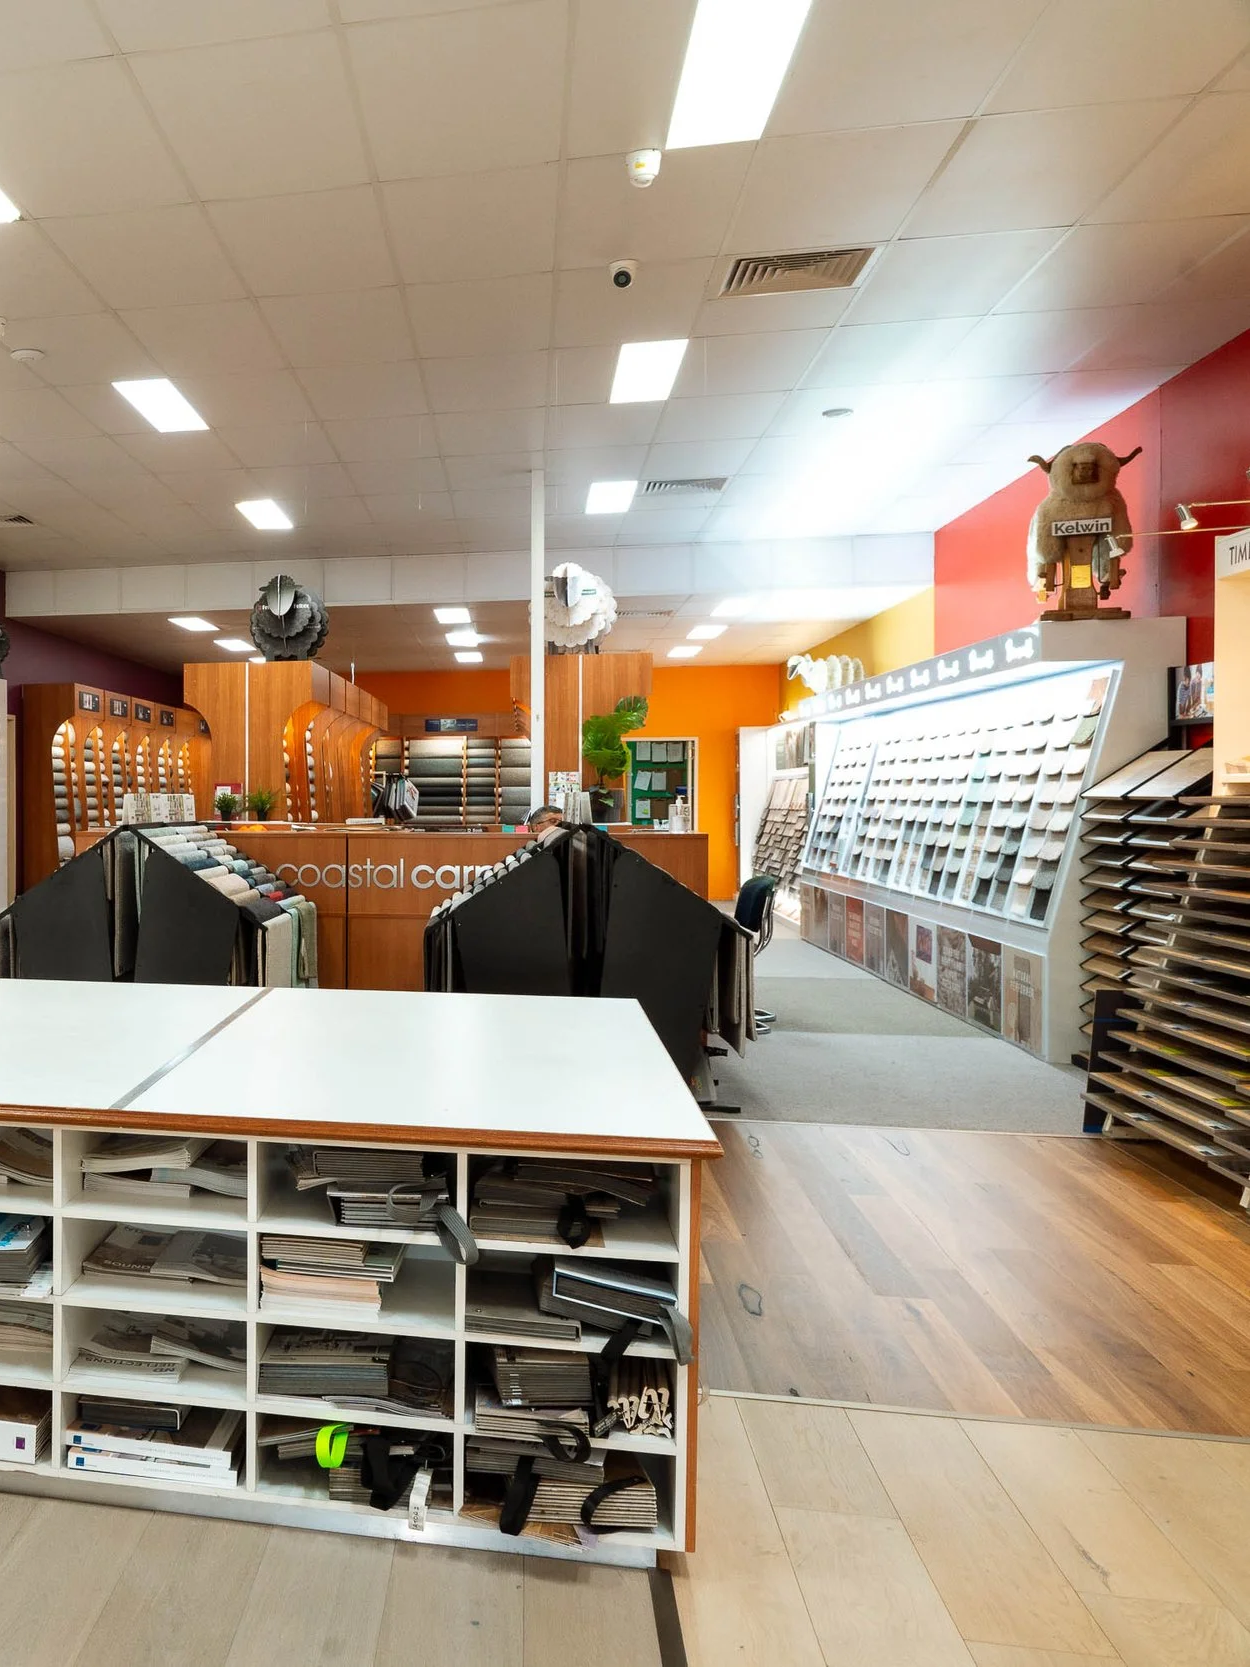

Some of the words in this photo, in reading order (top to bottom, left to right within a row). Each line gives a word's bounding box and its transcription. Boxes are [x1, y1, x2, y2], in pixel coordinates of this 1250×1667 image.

[1054, 519, 1110, 535] Kelwin
[1229, 541, 1250, 566] TIM
[275, 858, 404, 889] coastal
